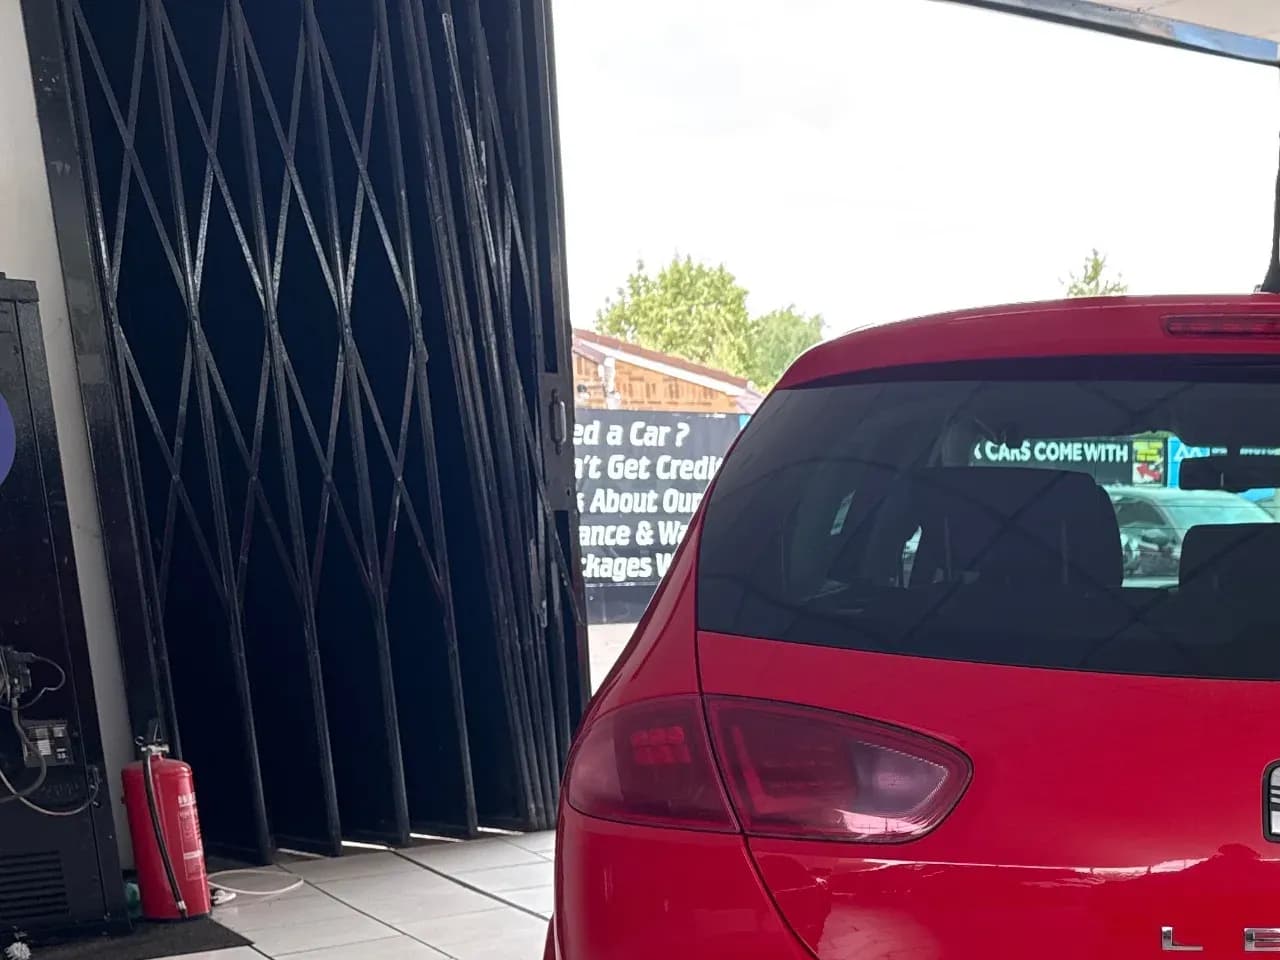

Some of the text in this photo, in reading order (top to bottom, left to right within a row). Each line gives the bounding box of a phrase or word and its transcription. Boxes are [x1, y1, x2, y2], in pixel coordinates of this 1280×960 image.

[606, 423, 623, 446] a
[629, 421, 671, 447] Car
[675, 422, 690, 447] ?
[1034, 441, 1082, 461] COME
[1083, 443, 1128, 463] WITH
[607, 454, 651, 480] Get
[589, 488, 658, 513] About
[635, 520, 655, 546] &
